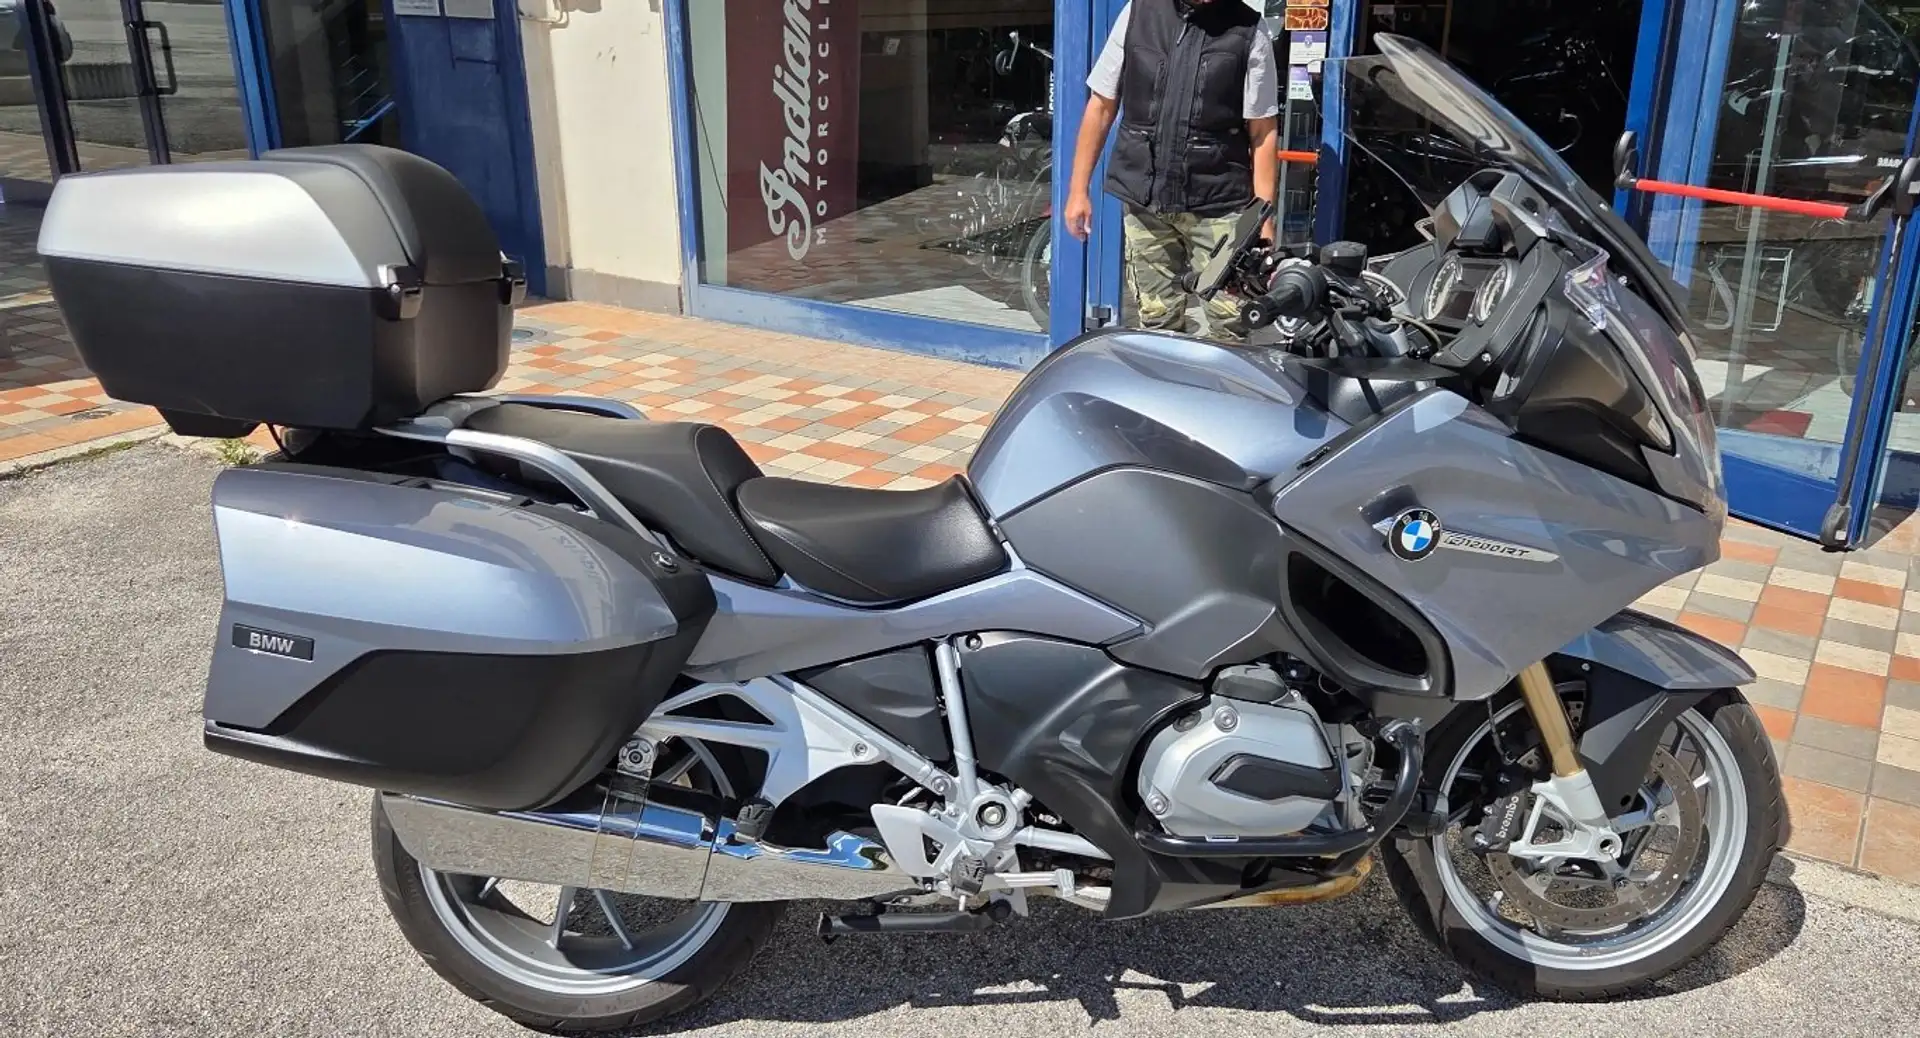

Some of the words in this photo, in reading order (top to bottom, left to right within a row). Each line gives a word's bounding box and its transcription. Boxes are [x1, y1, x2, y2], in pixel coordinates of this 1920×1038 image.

[760, 0, 811, 261] Indian
[816, 0, 830, 246] MOTORCYCL
[249, 632, 295, 653] BMW
[1495, 795, 1520, 839] brembo
